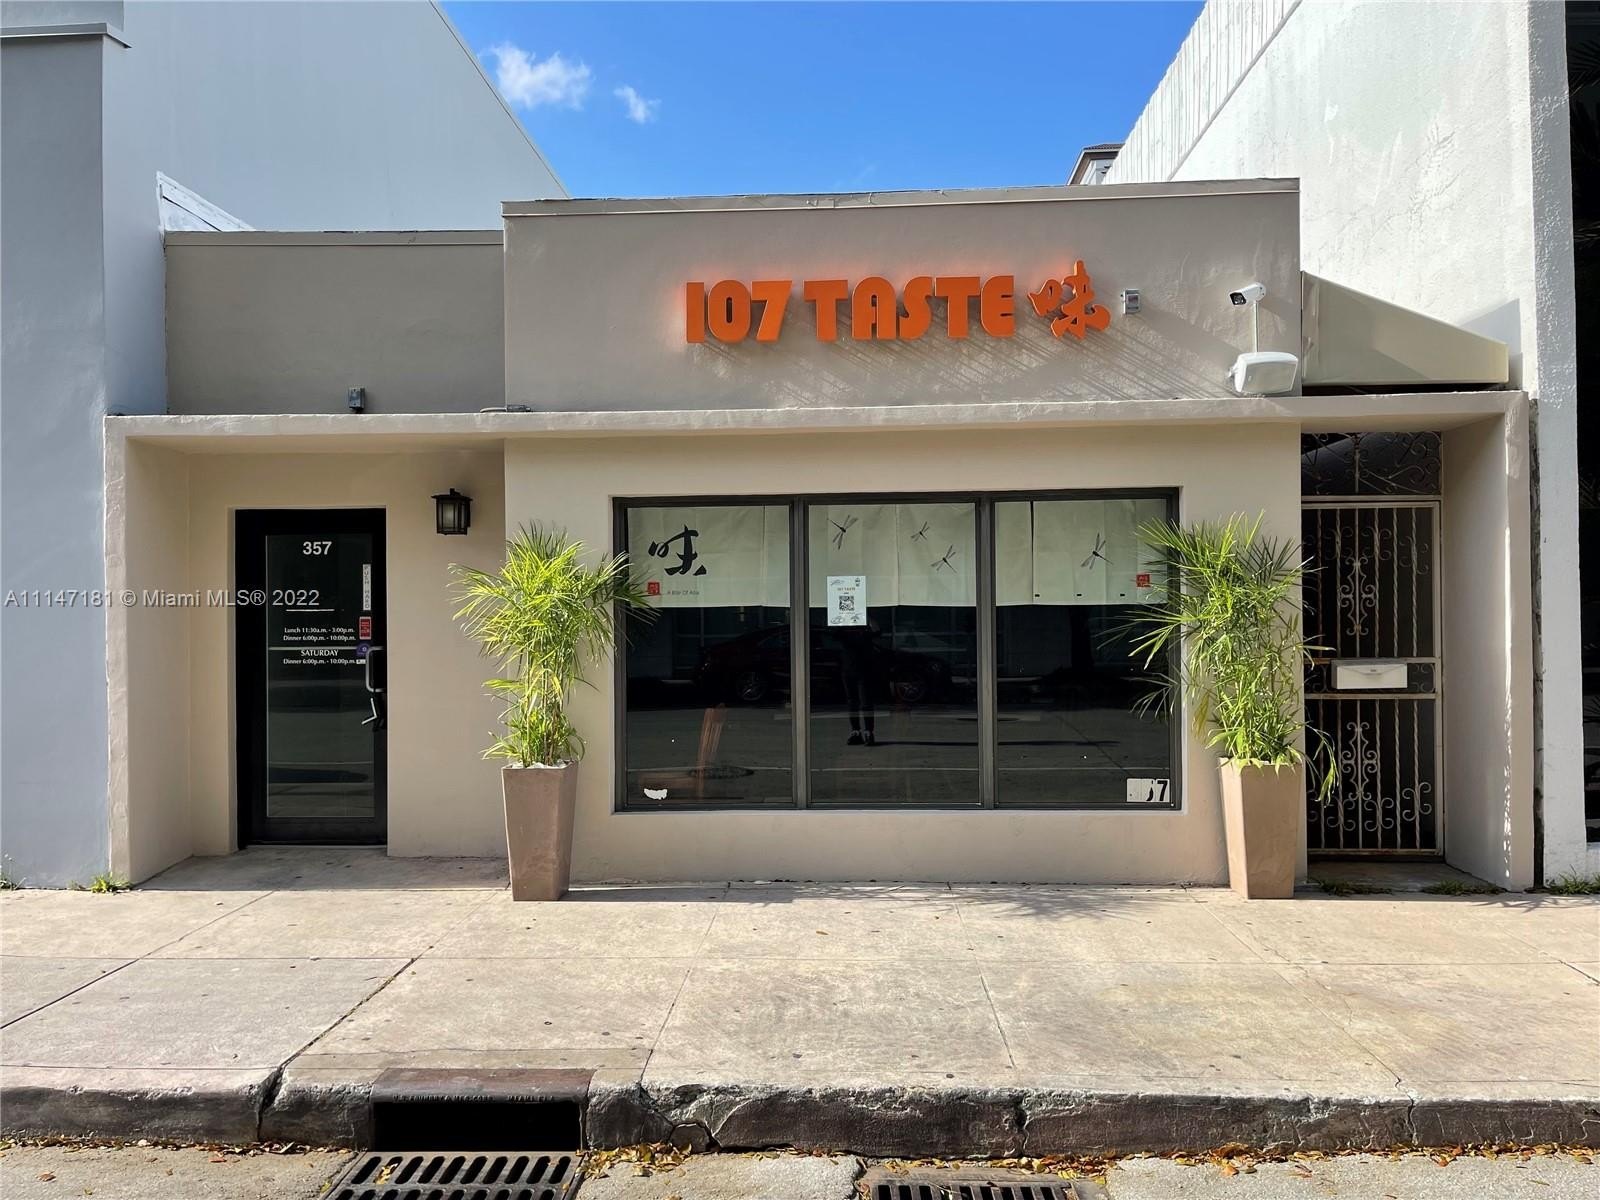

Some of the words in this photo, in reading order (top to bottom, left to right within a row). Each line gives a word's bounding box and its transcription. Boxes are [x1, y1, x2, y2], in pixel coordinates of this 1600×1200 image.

[686, 279, 793, 343] 107
[803, 275, 1015, 342] TASTE
[1027, 260, 1111, 339] 味
[302, 541, 332, 555] 357
